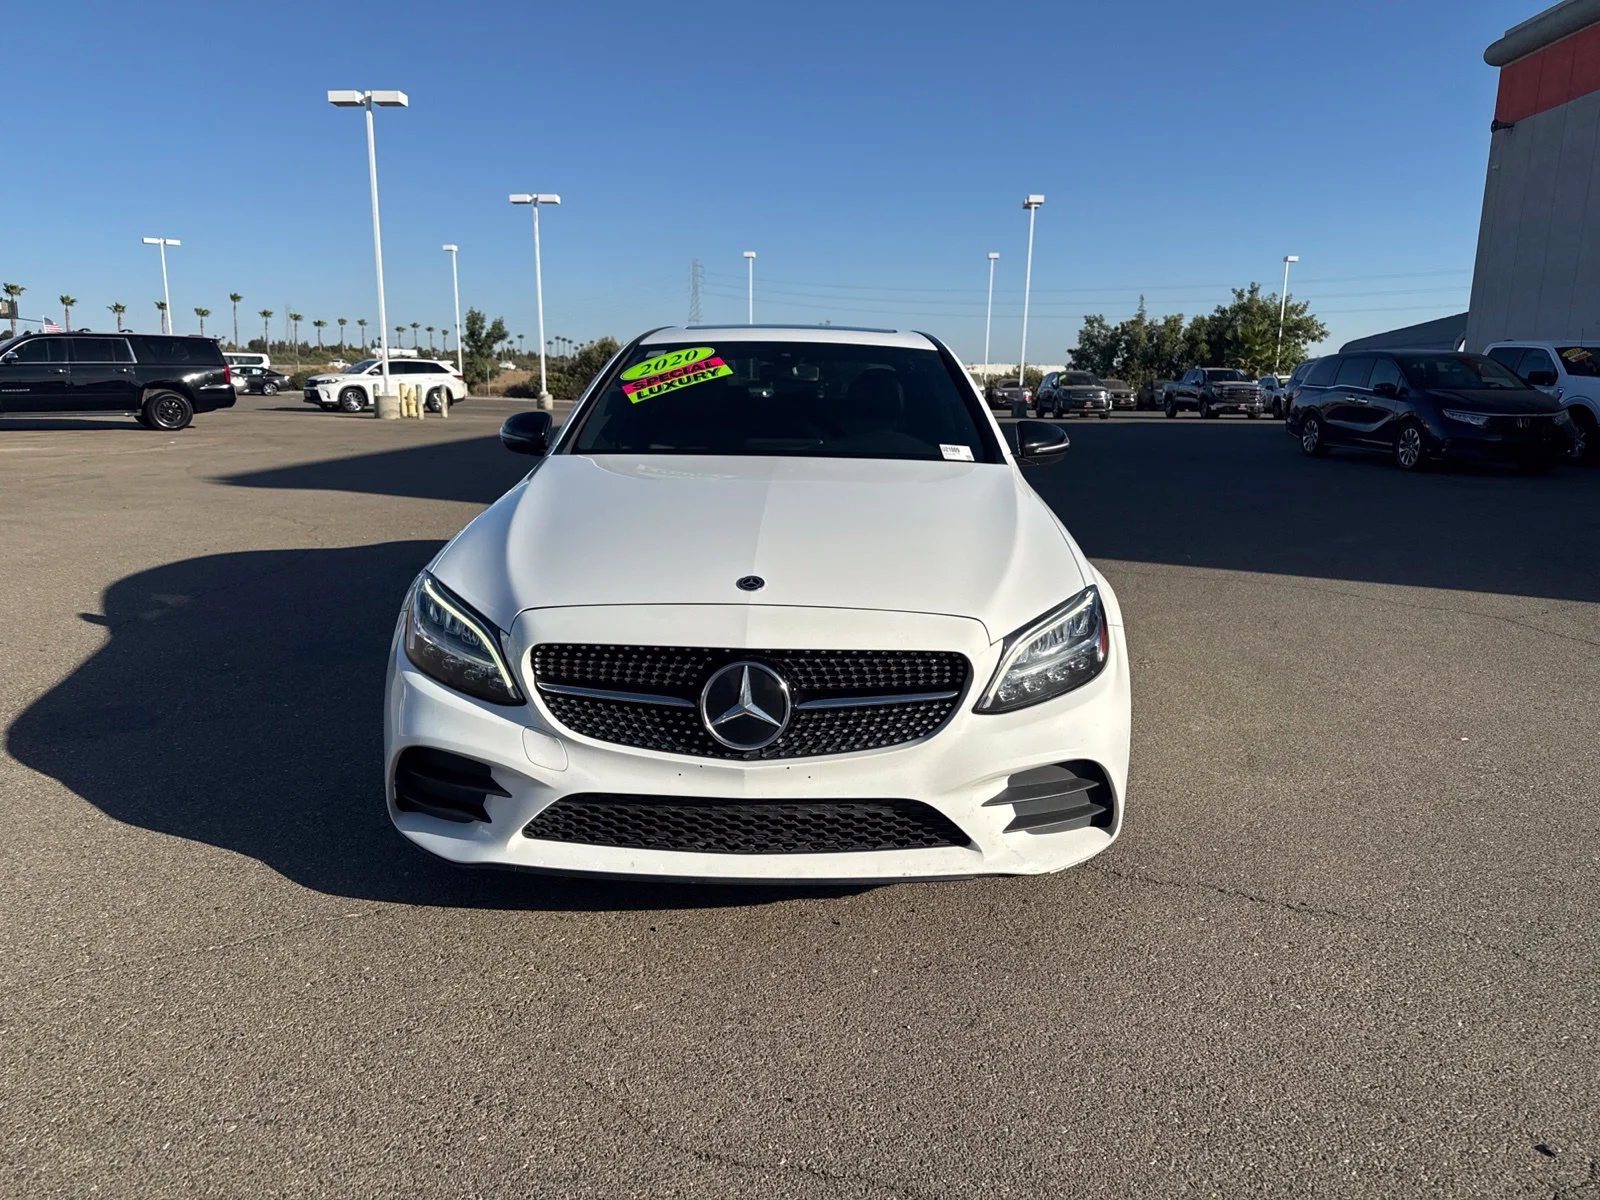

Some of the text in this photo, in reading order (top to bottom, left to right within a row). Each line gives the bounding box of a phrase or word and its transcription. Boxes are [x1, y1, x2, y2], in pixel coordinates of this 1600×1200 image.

[632, 360, 715, 391] SPECIAL
[639, 349, 699, 377] 2020
[636, 367, 722, 401] LUXURY
